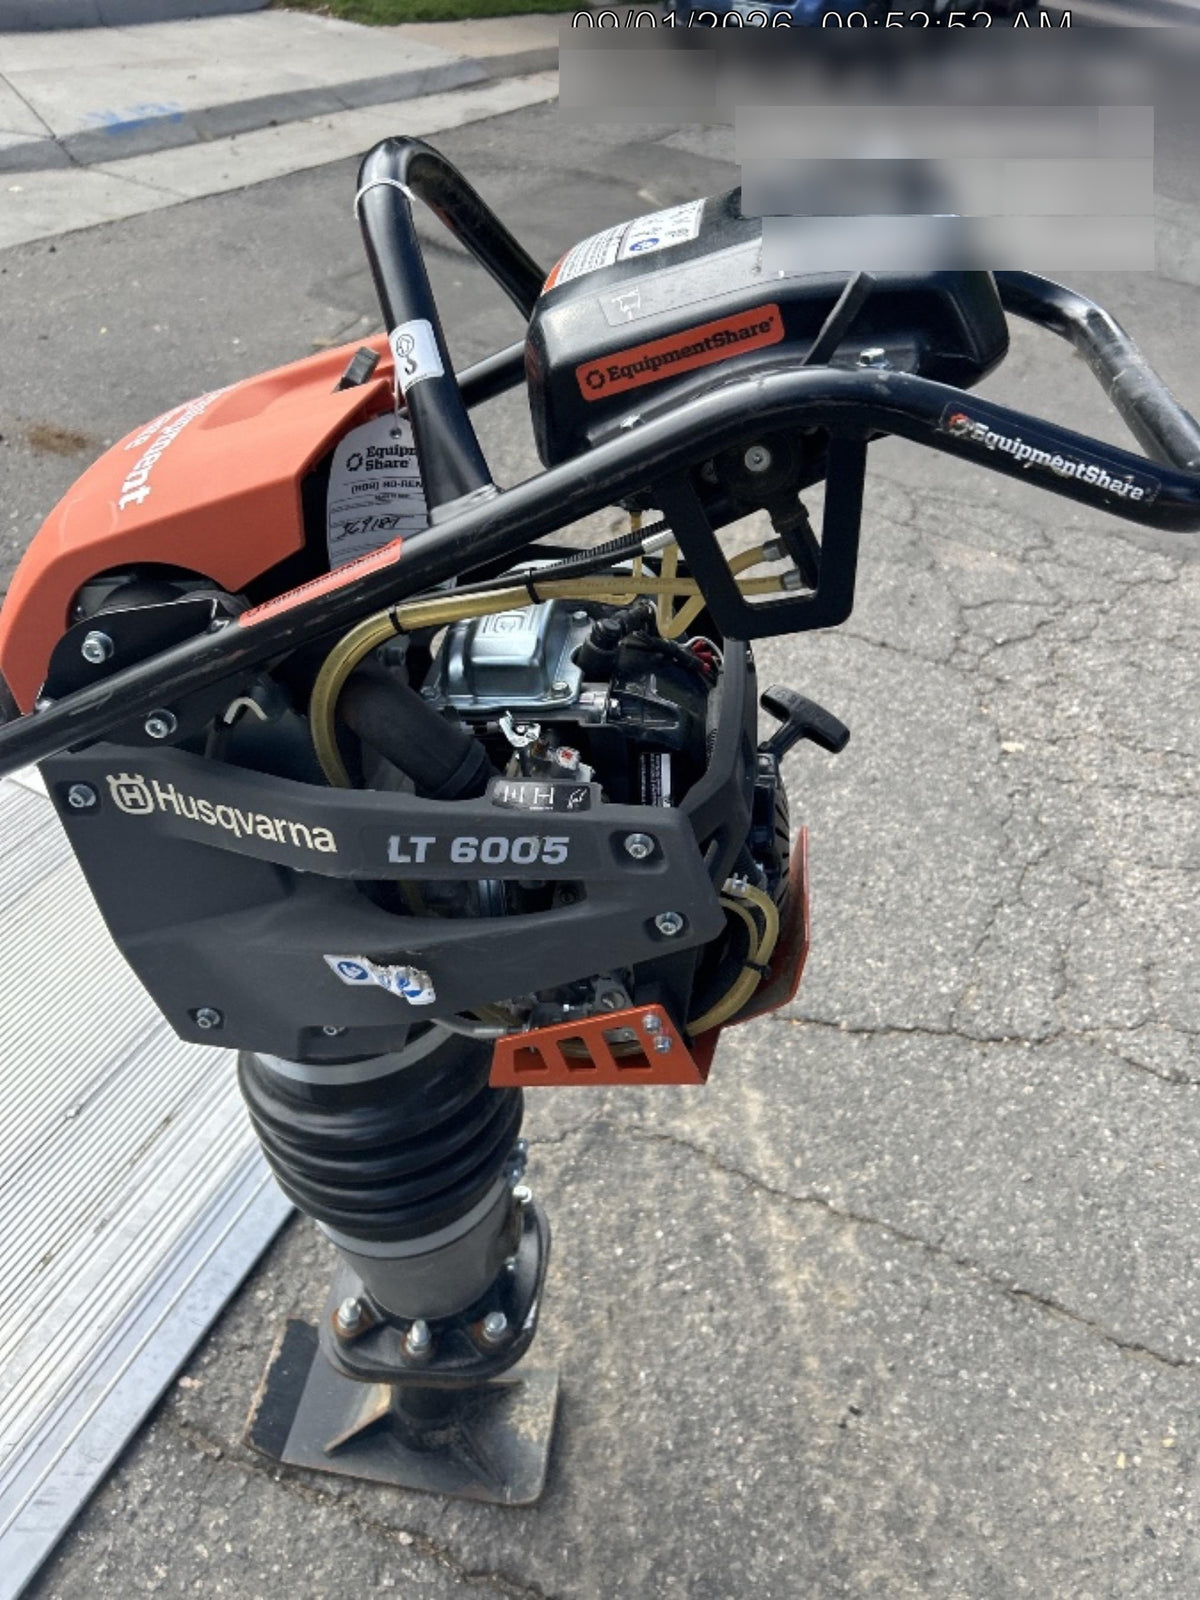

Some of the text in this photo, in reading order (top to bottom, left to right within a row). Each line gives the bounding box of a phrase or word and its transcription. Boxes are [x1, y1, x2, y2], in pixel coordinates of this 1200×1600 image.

[365, 458, 410, 472] Share
[366, 444, 416, 459] Equip
[970, 422, 1144, 501] EquipmentShare
[151, 779, 338, 853] Husqvarna
[388, 835, 570, 865] LT 6005
